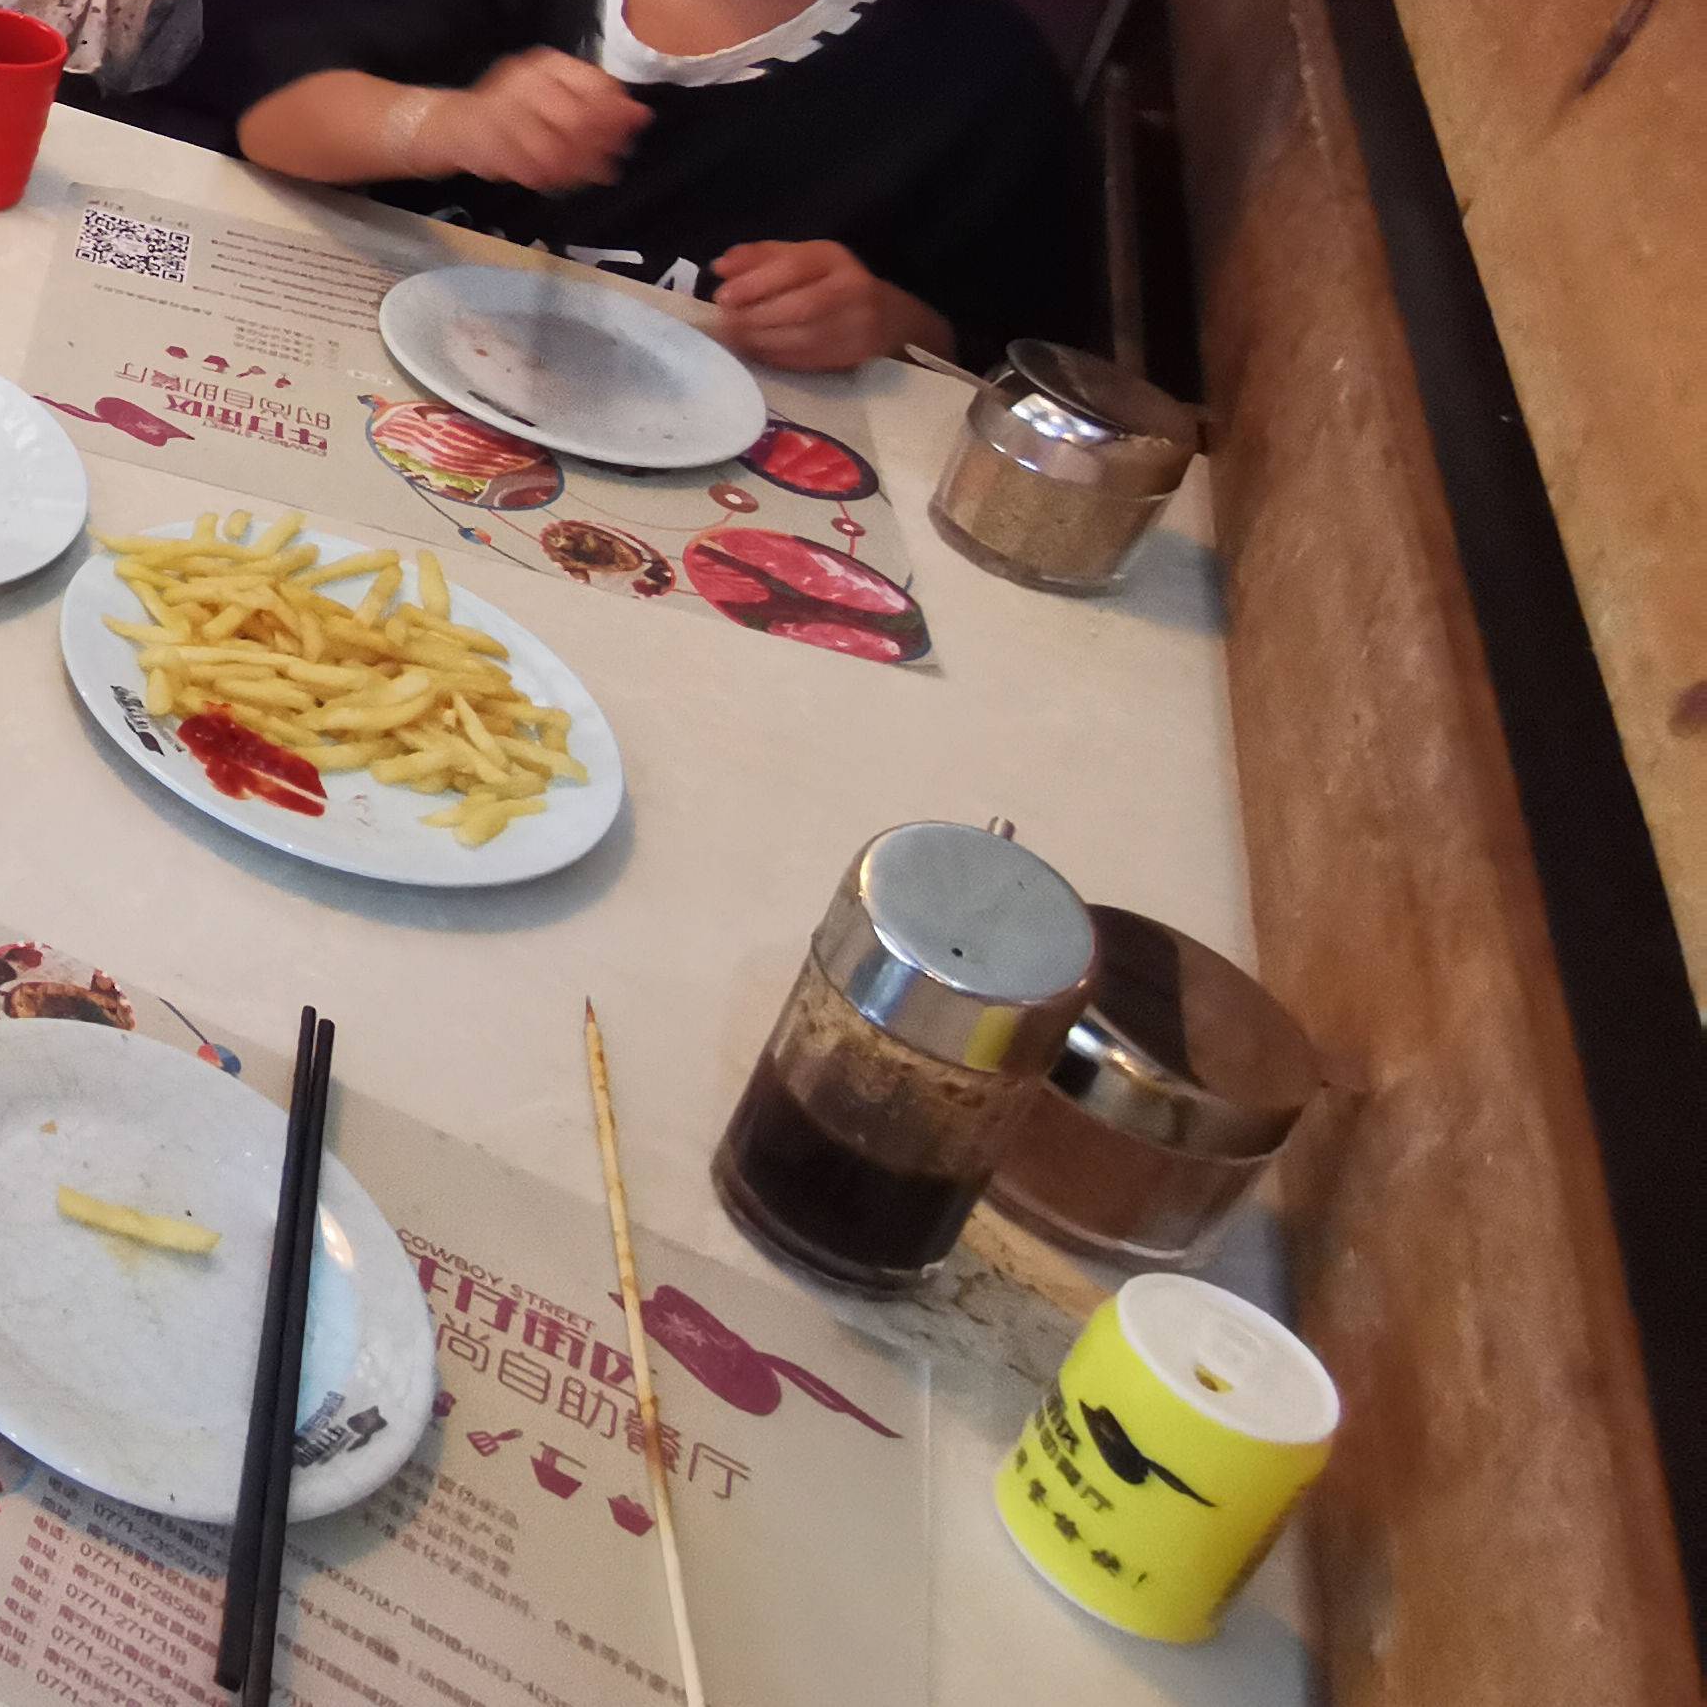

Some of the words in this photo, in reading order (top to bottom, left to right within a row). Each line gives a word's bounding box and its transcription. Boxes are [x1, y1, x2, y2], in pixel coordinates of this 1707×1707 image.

[396, 1229, 505, 1293] COWBOY
[510, 1282, 596, 1332] STREET
[432, 1307, 751, 1500] 尚自助餐厅
